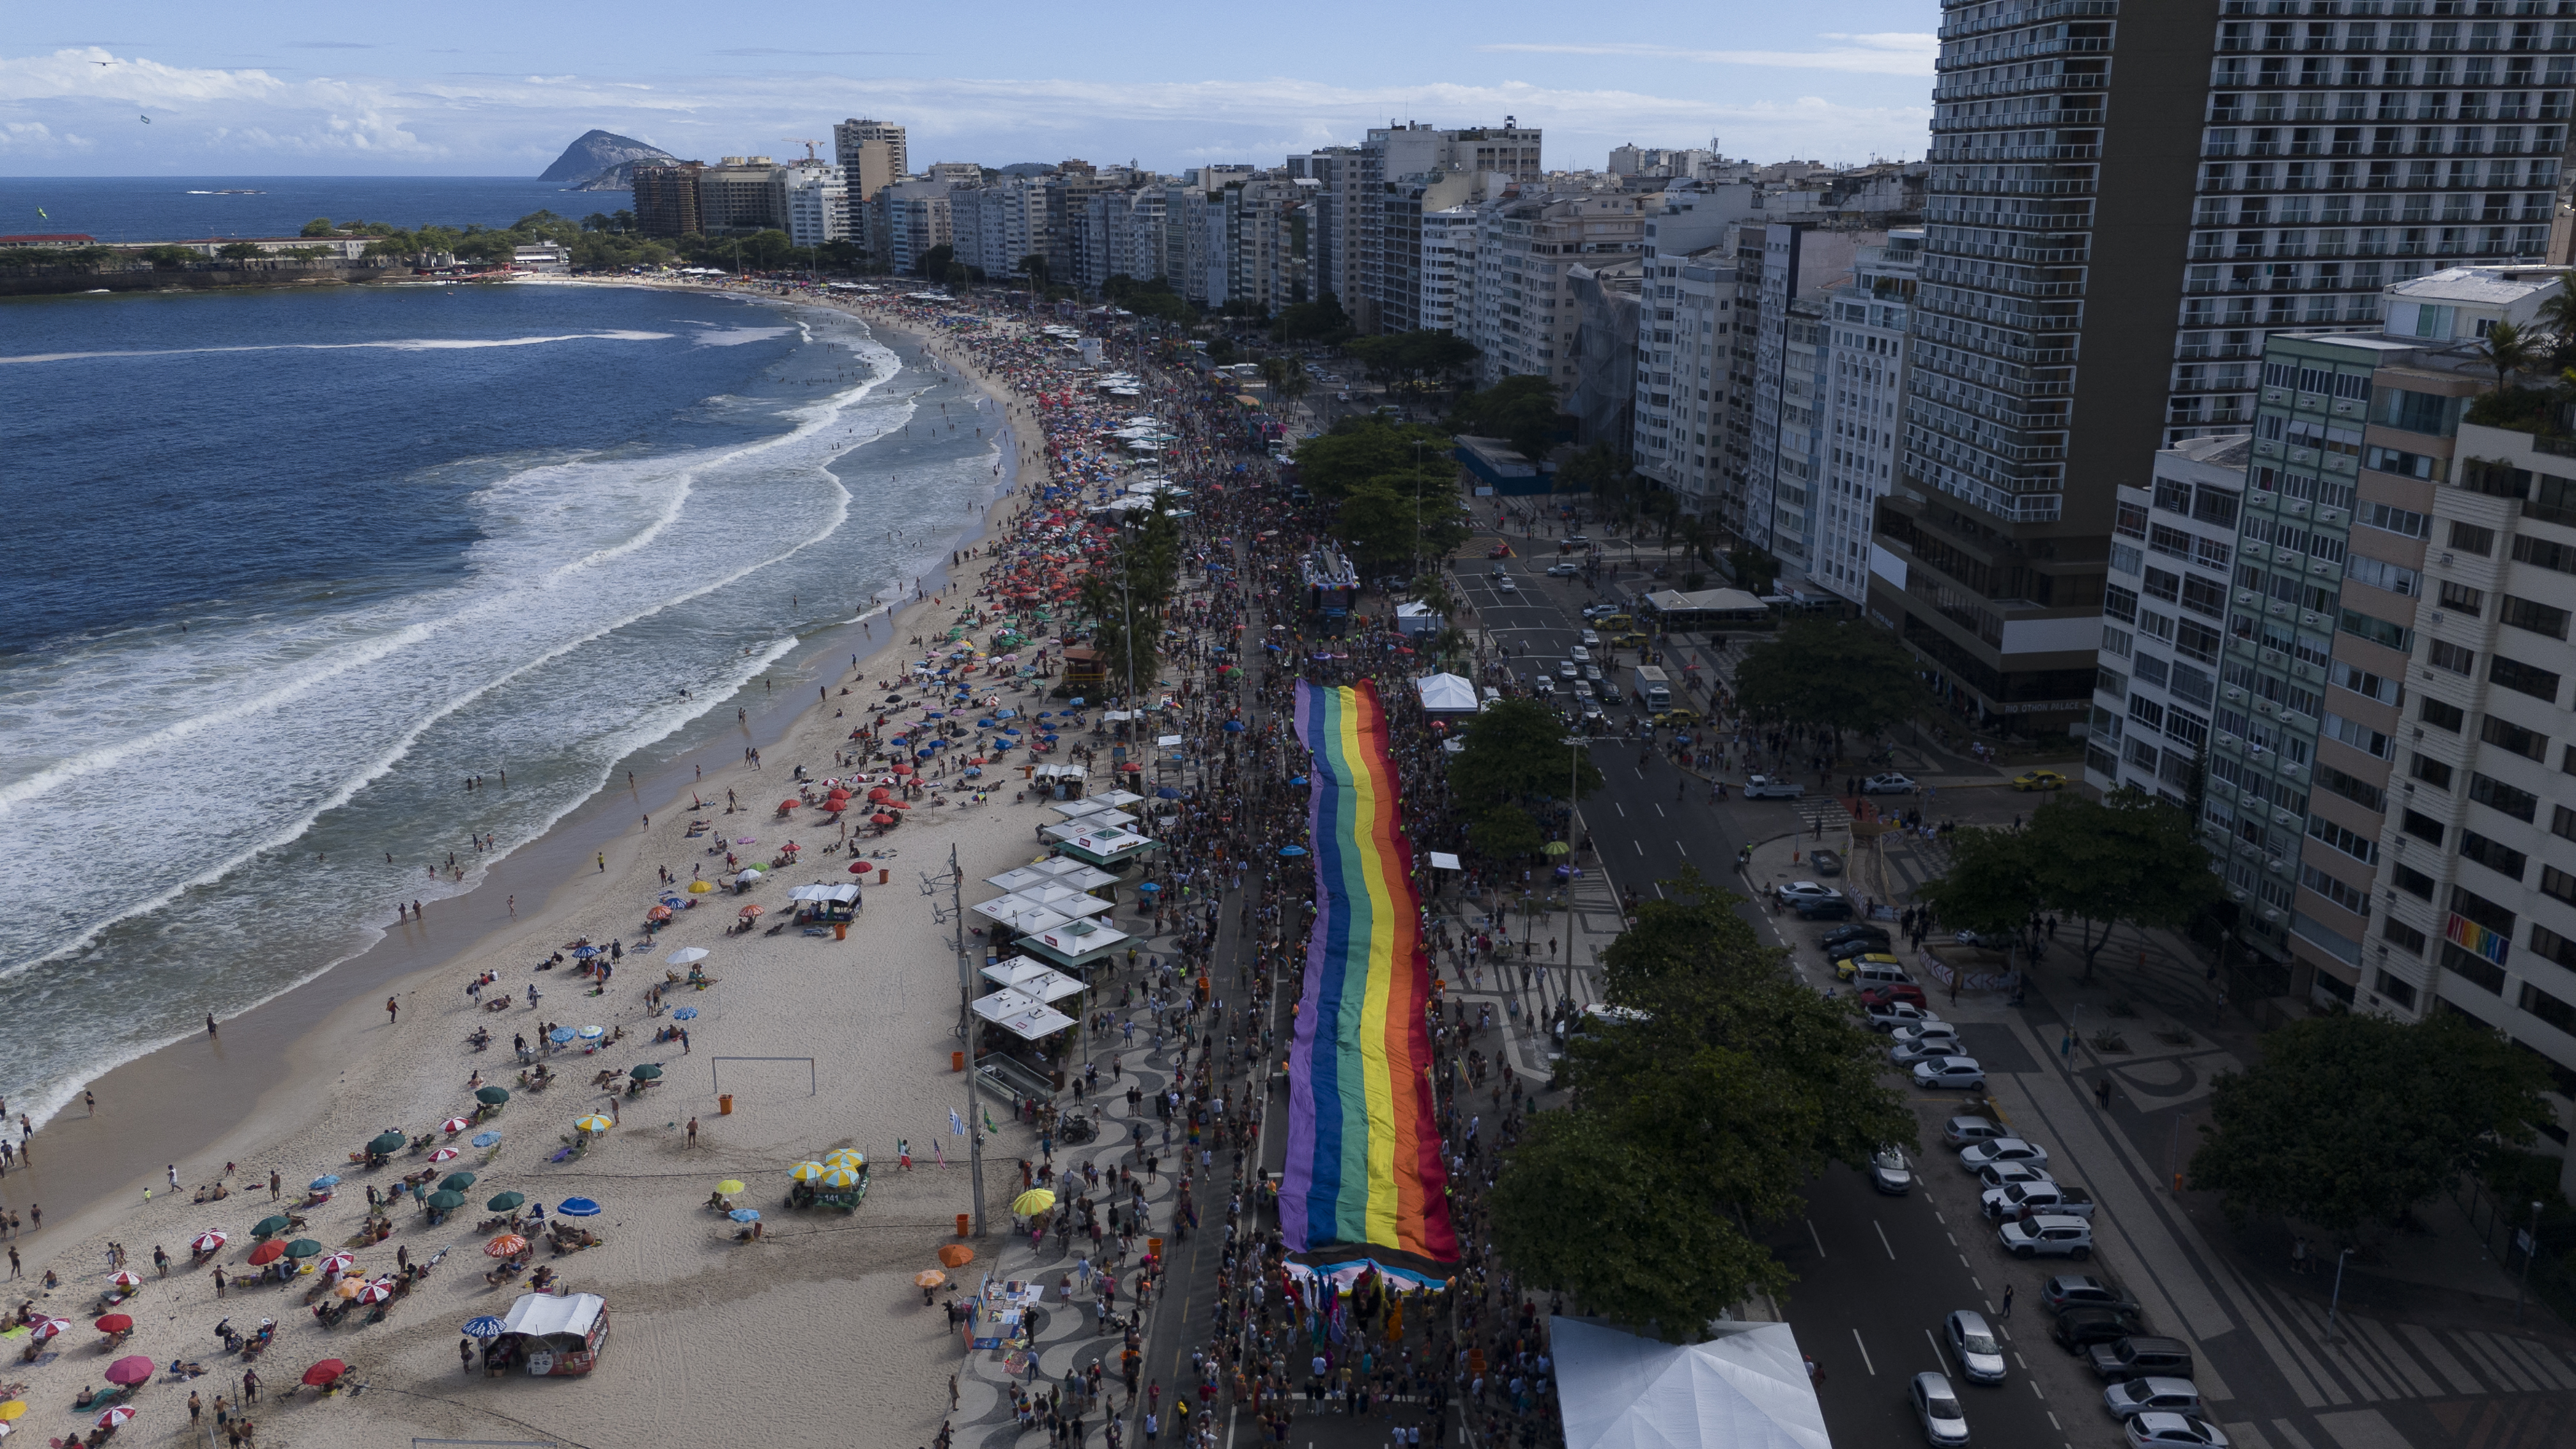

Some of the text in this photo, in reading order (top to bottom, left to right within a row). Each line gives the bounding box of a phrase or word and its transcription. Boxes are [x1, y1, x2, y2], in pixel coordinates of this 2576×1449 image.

[2005, 702, 2079, 713] RIO OTHON PALACE
[825, 1193, 839, 1202] 141
